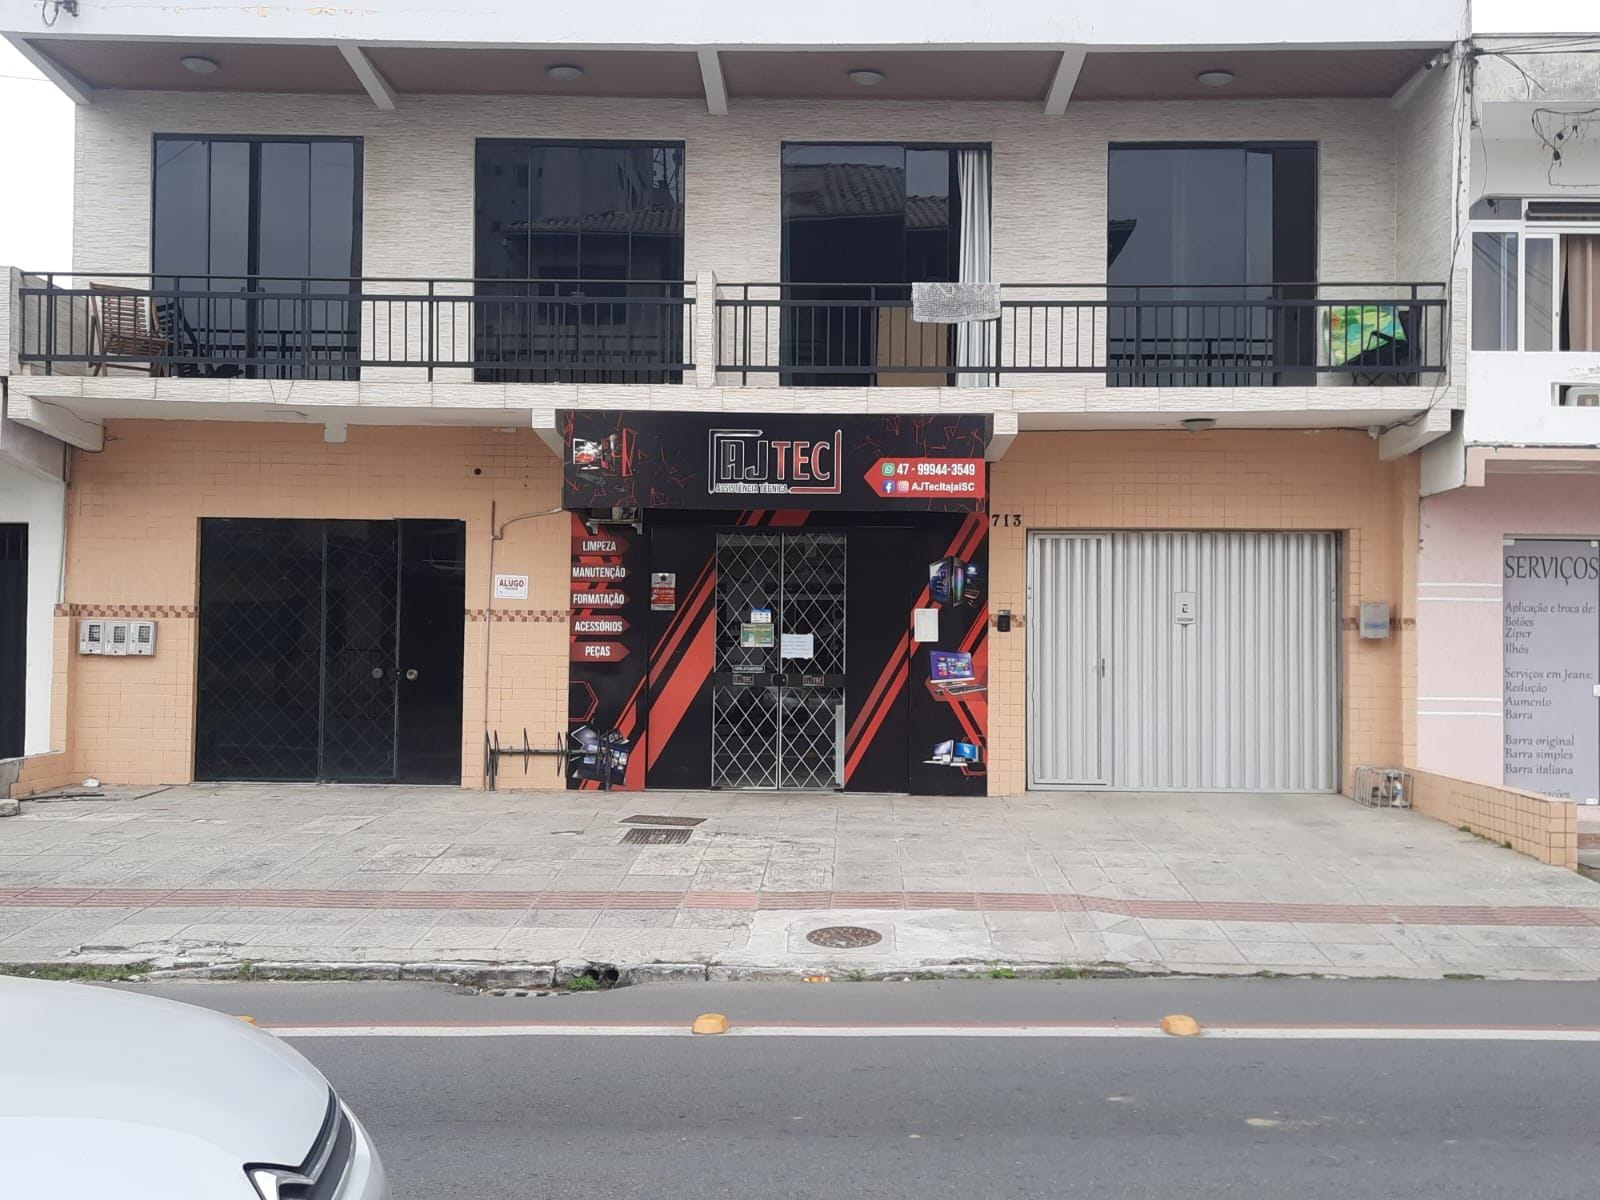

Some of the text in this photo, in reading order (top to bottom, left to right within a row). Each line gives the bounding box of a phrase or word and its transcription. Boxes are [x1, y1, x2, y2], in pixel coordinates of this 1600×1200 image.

[896, 463, 909, 476] 47
[917, 463, 976, 476] 99944-3549
[991, 513, 1022, 528] 713
[582, 541, 617, 552] LIMPEZA
[572, 565, 626, 579] MANUTENÇÃO
[1504, 555, 1599, 587] SERVIÇOS
[499, 579, 525, 588] ALUGO
[572, 592, 625, 606] FORMATAÇÃO
[1505, 600, 1549, 615] Aplicação
[1550, 605, 1556, 613] e
[1557, 603, 1580, 614] troca
[574, 619, 623, 632] ACESSÓRIOS
[1505, 616, 1535, 627] Botões
[585, 646, 611, 658] PEÇAS
[1505, 668, 1545, 681] Serviços
[1546, 671, 1561, 679] em
[1505, 681, 1548, 696] Redução
[1505, 696, 1552, 707] Aumento
[1505, 709, 1533, 720] Barra
[1505, 734, 1575, 750] Barra original
[1505, 748, 1574, 762] Barra simples
[1505, 763, 1574, 775] Barra italiana
